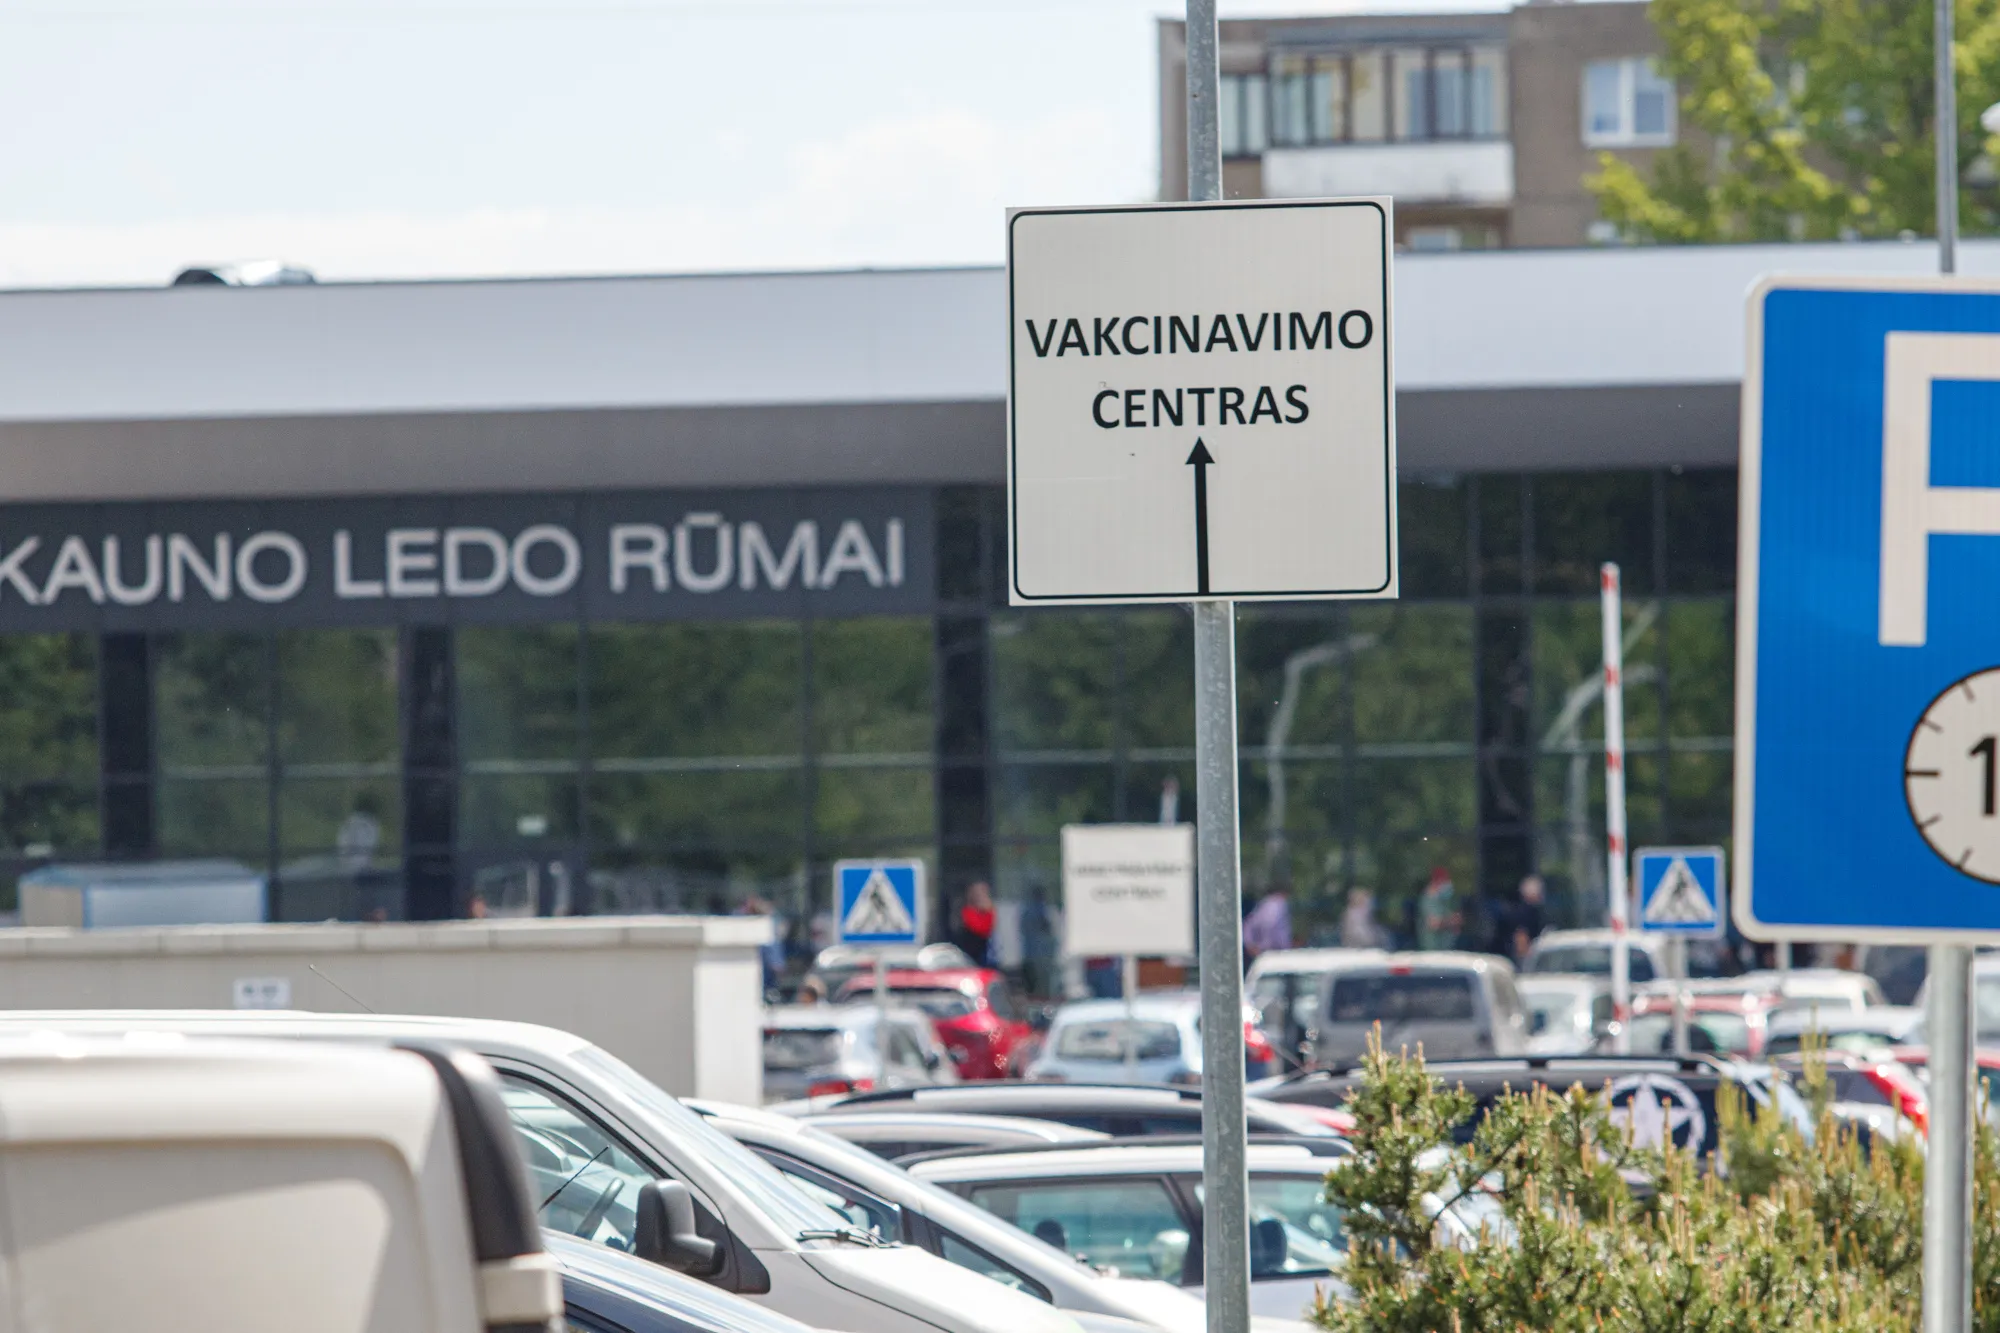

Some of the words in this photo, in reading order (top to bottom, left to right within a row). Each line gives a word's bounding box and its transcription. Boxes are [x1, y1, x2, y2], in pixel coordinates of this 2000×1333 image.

[1025, 309, 1374, 358] VAKCINAVIMO
[1092, 384, 1310, 429] CENTRAS
[0, 530, 308, 606] KAUNO
[333, 524, 582, 598] LEDO
[610, 511, 905, 594] RŪMAI
